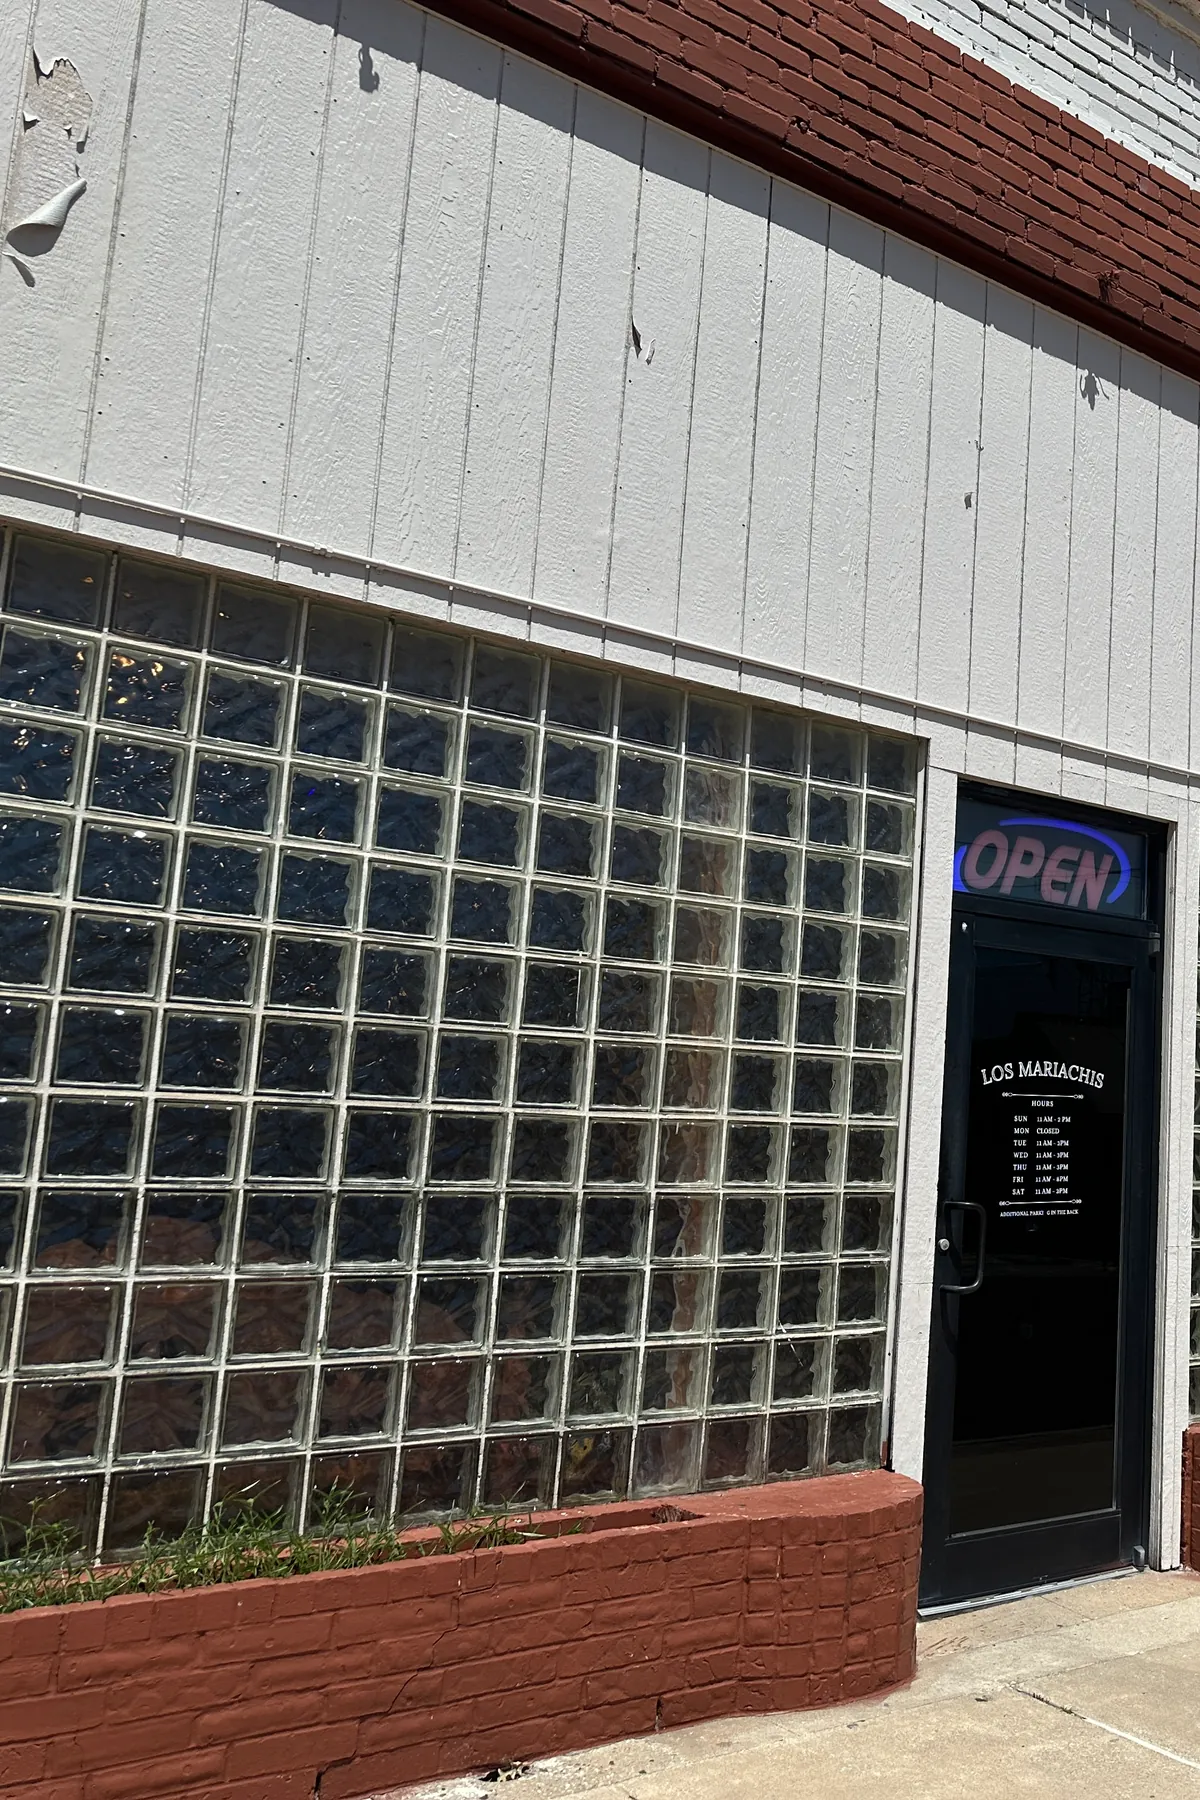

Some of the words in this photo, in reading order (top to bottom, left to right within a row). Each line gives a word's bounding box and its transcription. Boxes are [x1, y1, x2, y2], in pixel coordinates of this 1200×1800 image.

[963, 828, 1114, 911] OPEN
[980, 1062, 1015, 1086] LOS
[1018, 1060, 1105, 1089] MARIACHIS
[1036, 1127, 1060, 1135] CLOSED
[1013, 1139, 1027, 1147] TUE
[1042, 1151, 1053, 1159] AM
[1012, 1163, 1028, 1171] THU
[1042, 1163, 1052, 1171] AM
[1042, 1175, 1052, 1183] AM
[1012, 1188, 1026, 1196] SAT
